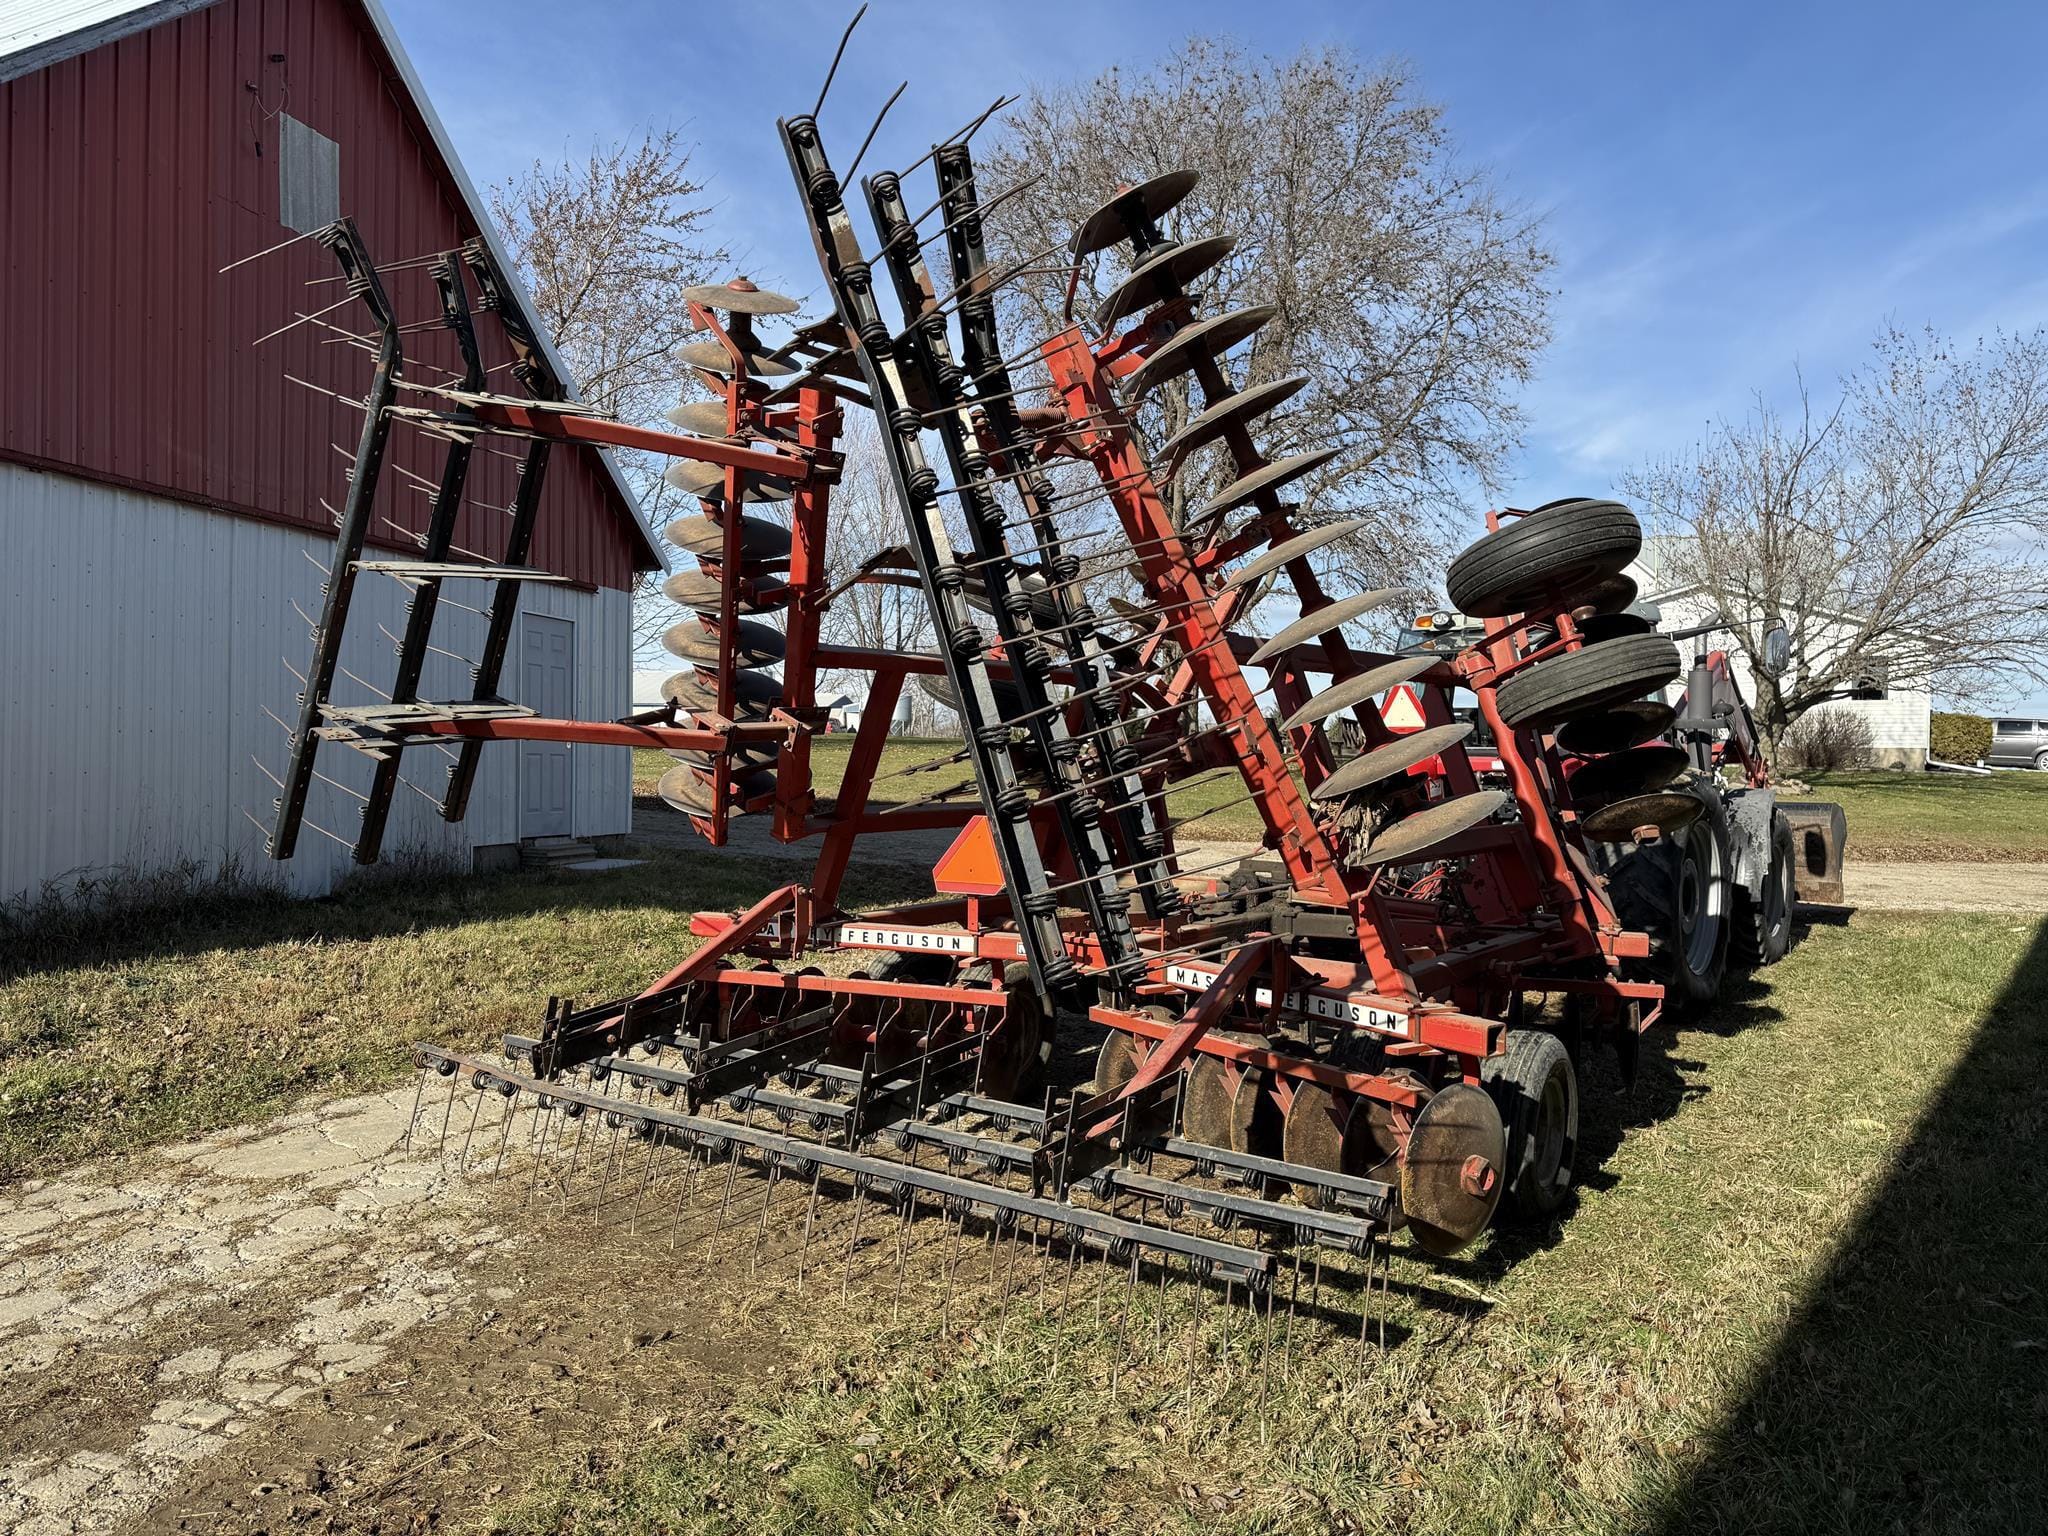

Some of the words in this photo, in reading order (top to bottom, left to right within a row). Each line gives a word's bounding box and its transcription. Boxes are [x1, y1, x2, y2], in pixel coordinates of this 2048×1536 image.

[848, 931, 960, 950] FERGUSON
[1176, 968, 1212, 988] MAS
[1286, 993, 1396, 1030] ERGUSON
